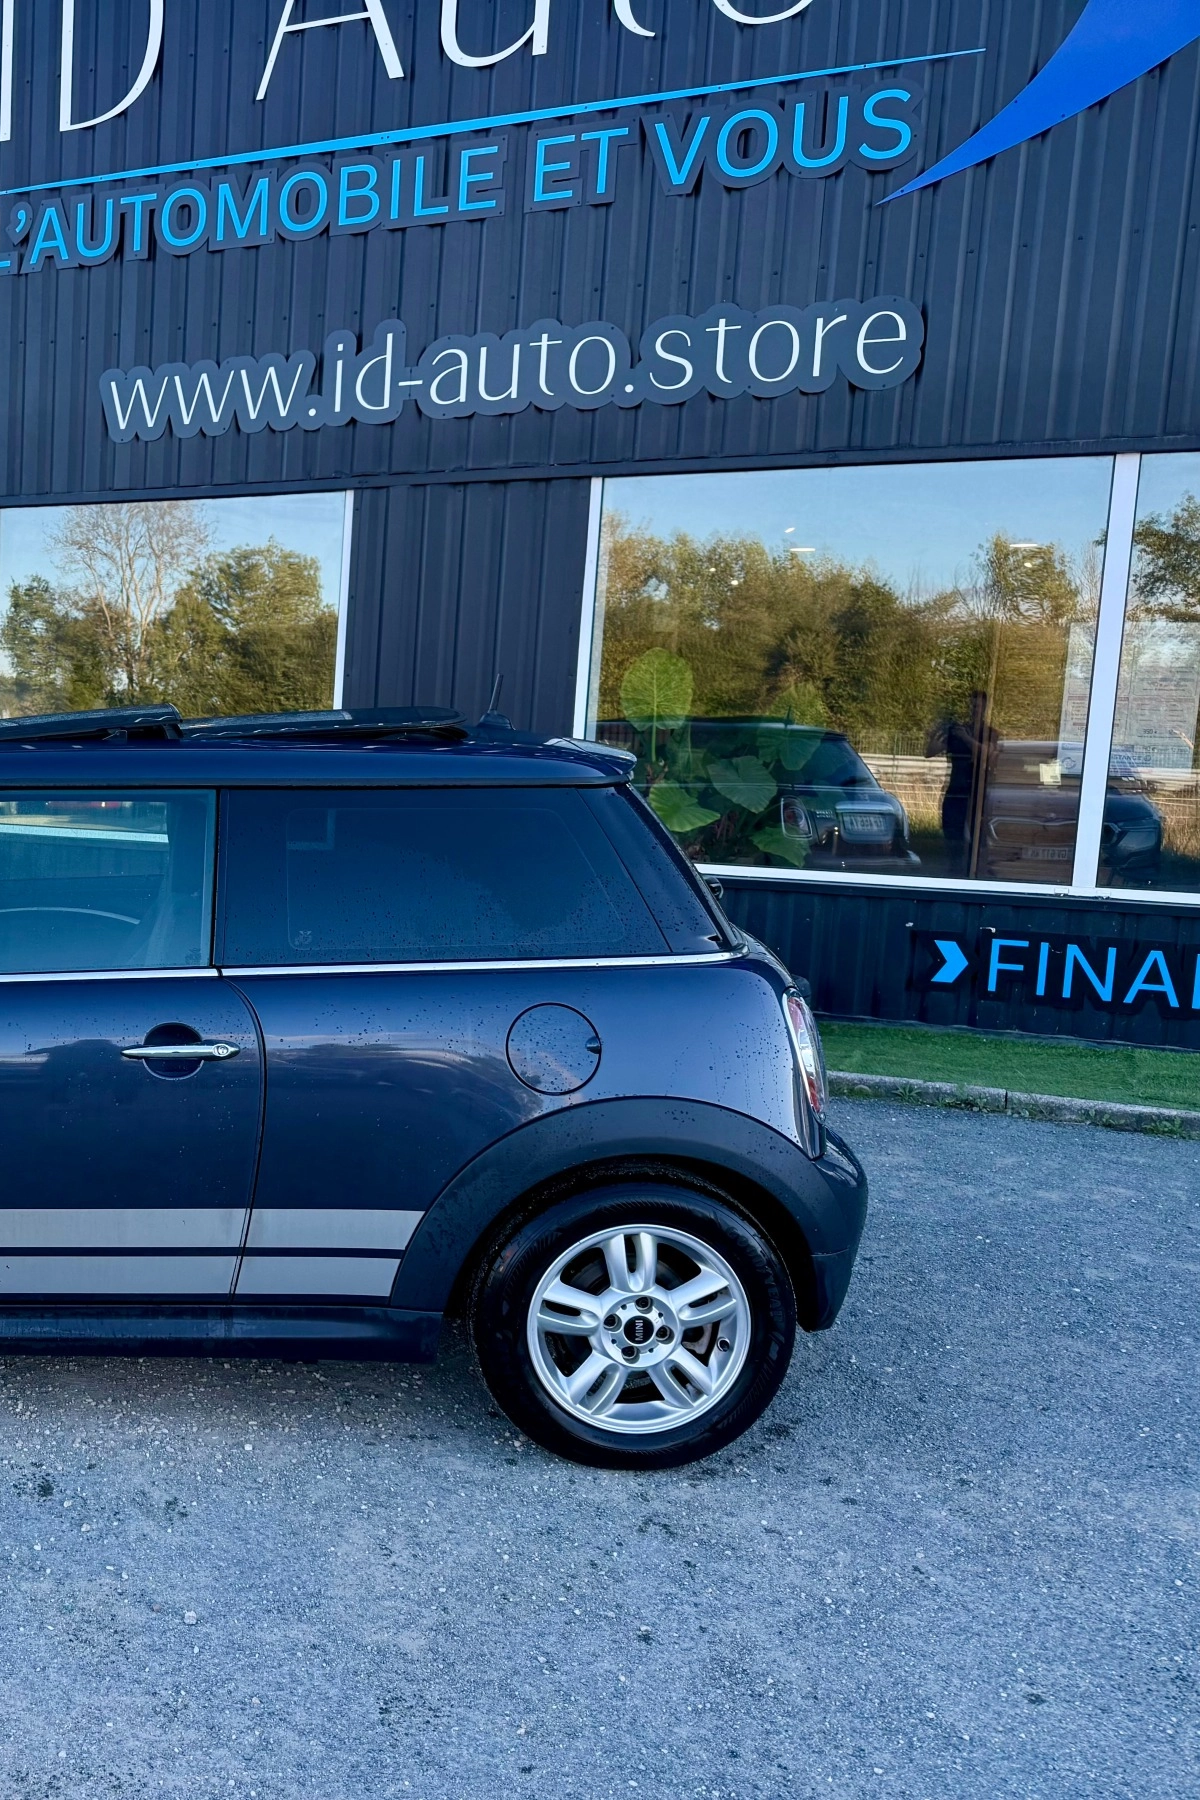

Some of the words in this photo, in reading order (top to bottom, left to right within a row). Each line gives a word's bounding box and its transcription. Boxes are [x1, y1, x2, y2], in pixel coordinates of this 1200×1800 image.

[533, 127, 629, 203] ET
[654, 88, 914, 186] VOUS
[110, 310, 907, 430] www.id-auto.store
[987, 938, 1200, 1009] FINA
[634, 1319, 644, 1341] MINI
